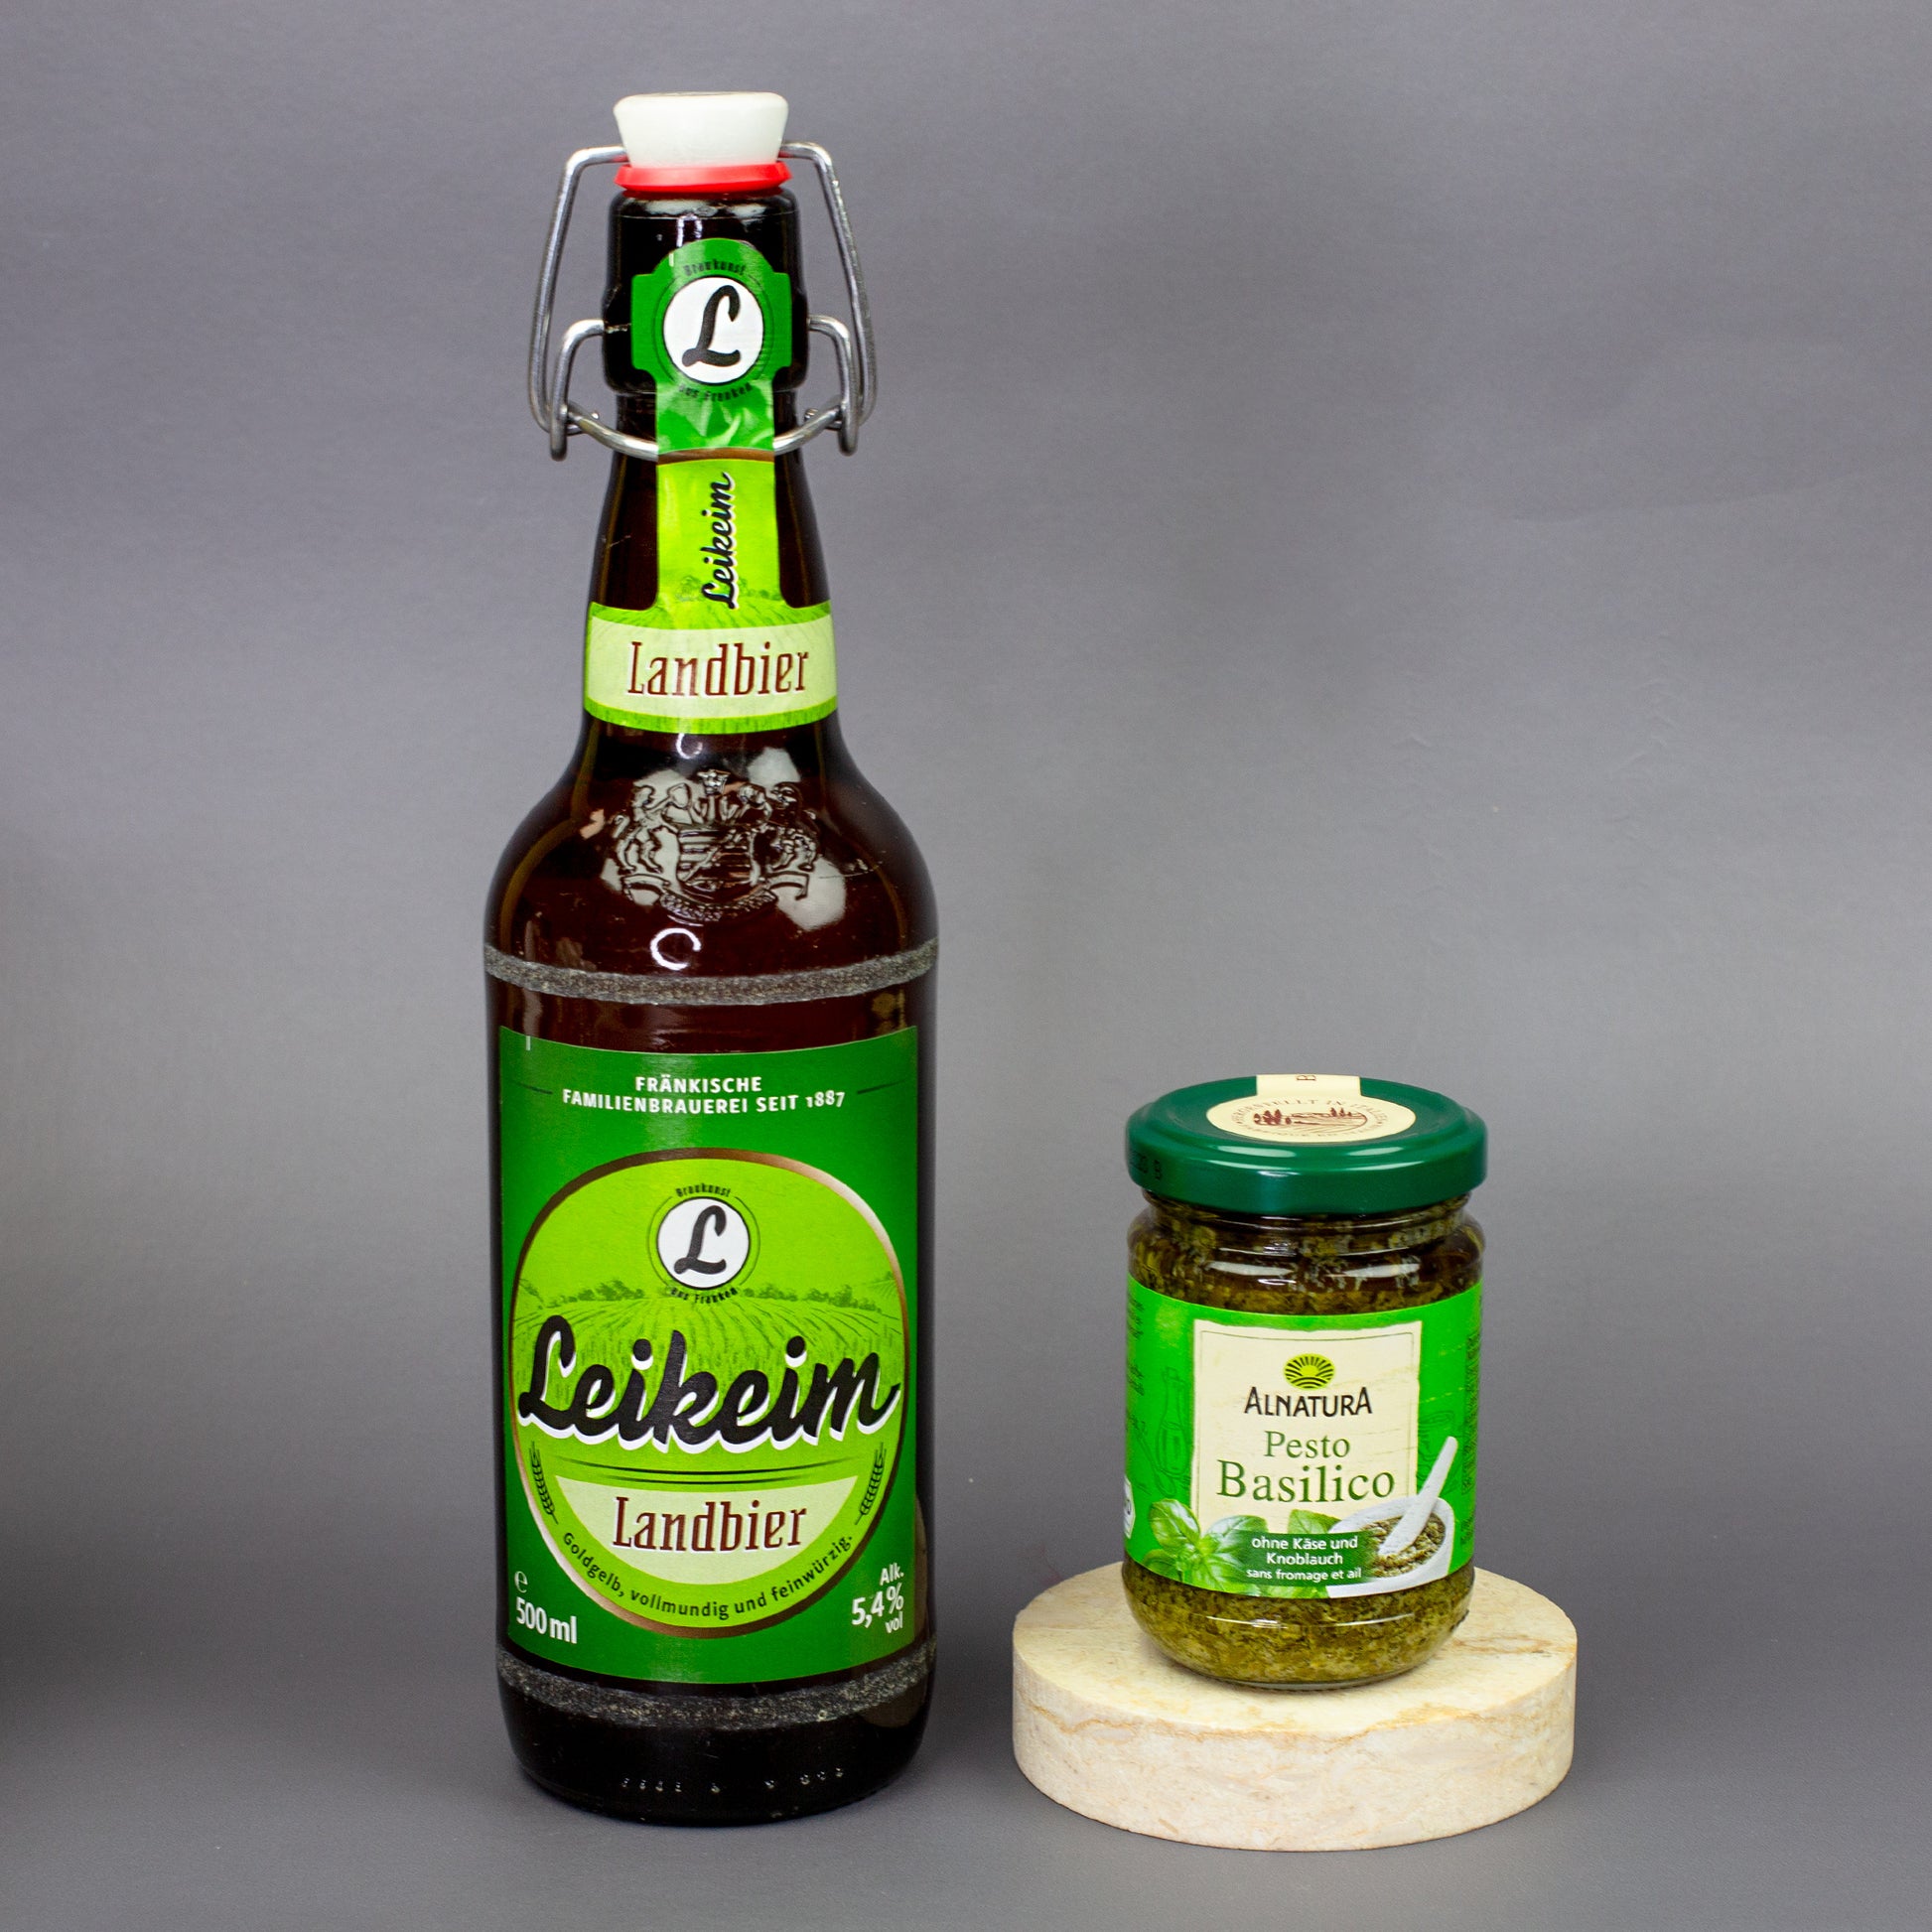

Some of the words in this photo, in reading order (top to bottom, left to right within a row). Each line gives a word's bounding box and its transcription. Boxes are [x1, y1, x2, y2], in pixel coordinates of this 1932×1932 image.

[682, 285, 741, 367] L
[701, 472, 738, 610] Leikeim
[627, 641, 809, 697] Landbier
[635, 1074, 762, 1094] FRÄNKISCHE
[562, 1088, 748, 1115] FAMILIENBRAUEREI
[756, 1095, 798, 1112] SEIT
[806, 1090, 845, 1108] 1887
[674, 1205, 727, 1275] L
[518, 1314, 901, 1454] Leikeim
[1244, 1386, 1373, 1418] ALNATURA
[1264, 1430, 1351, 1459] Pesto
[1216, 1459, 1396, 1503] Basilico
[613, 1496, 808, 1552] Landbier
[1251, 1535, 1290, 1549] ohne
[1292, 1536, 1327, 1550] Käse
[1330, 1535, 1359, 1549] und
[880, 1563, 904, 1586] Alk.
[1266, 1552, 1344, 1566] Knoblauch
[563, 1532, 624, 1597] Goldgelb,
[630, 1588, 730, 1620] vollmundig
[735, 1591, 767, 1614] und
[771, 1536, 853, 1601] feinwürzig.
[1246, 1569, 1273, 1580] sans
[1276, 1569, 1329, 1584] fromage
[1331, 1569, 1345, 1580] et
[1347, 1567, 1362, 1579] ail
[886, 1611, 903, 1634] vol
